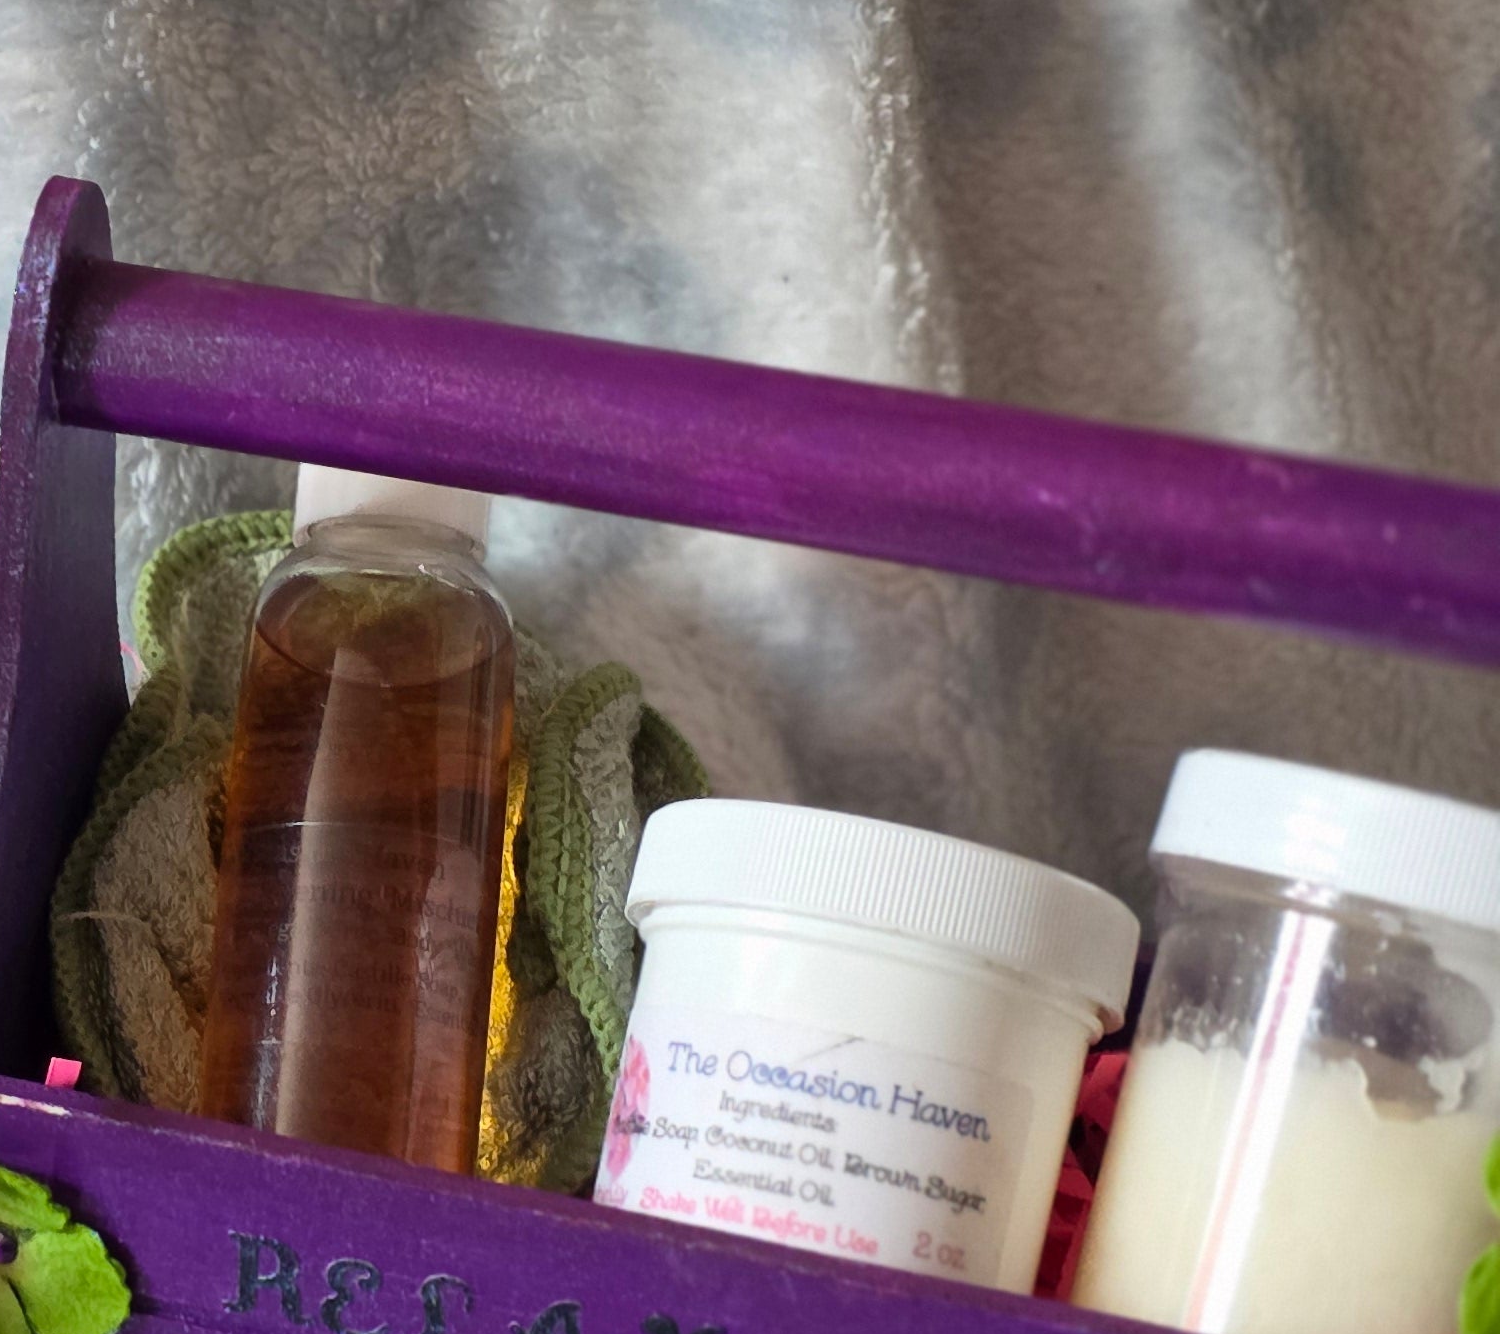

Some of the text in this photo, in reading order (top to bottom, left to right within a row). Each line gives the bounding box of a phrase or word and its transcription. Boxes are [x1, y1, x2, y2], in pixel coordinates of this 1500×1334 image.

[668, 1040, 992, 1144] The Occasion Haven
[693, 1157, 795, 1199] Essential
[705, 1124, 796, 1162] Coconut
[843, 1151, 923, 1196] Brown
[638, 1184, 697, 1218] Shake
[750, 1204, 829, 1247] Before
[831, 1223, 881, 1258] Use
[911, 1229, 934, 1260] 2
